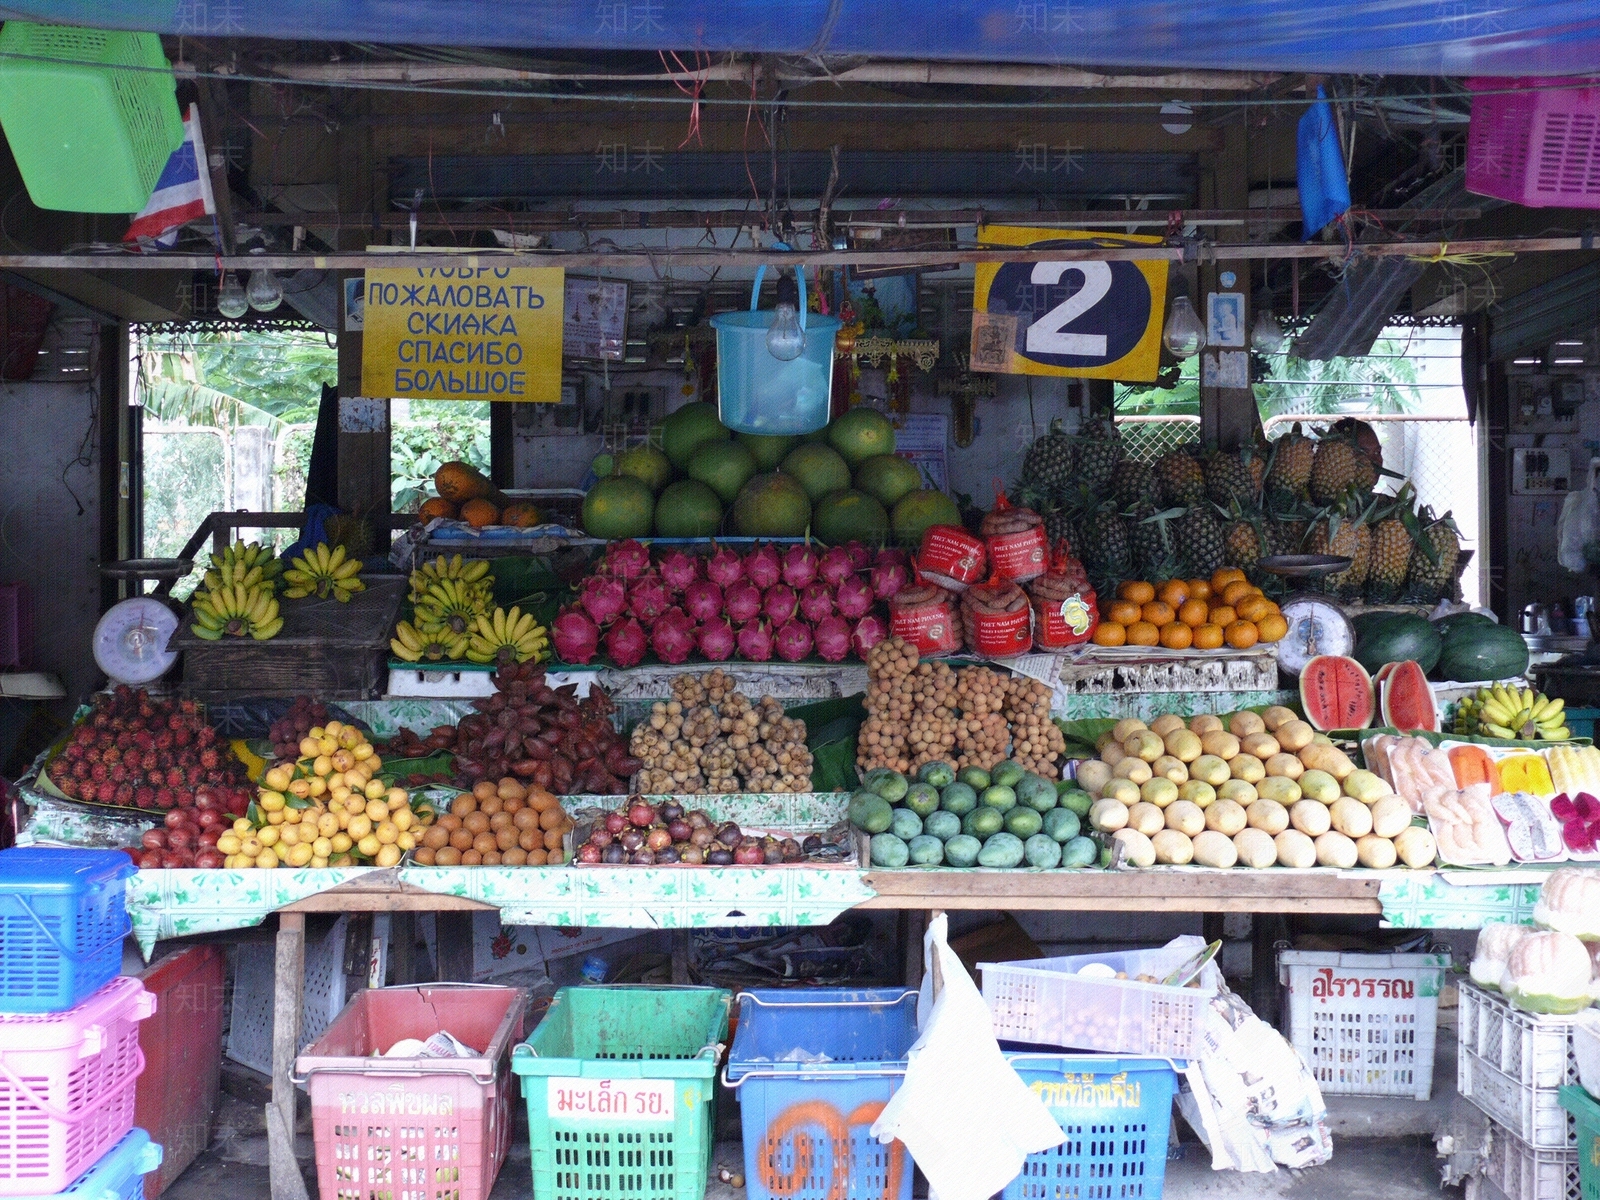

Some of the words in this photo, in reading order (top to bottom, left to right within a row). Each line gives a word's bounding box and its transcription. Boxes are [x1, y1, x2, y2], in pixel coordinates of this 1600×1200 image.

[368, 282, 545, 310] ПОЖАЛОВАТЬ
[1026, 260, 1113, 357] 2
[398, 339, 524, 366] СПАСИБО
[394, 368, 527, 395] БОЛЬШОЕ
[1312, 968, 1414, 1004] อุไรวรรณ
[557, 1079, 627, 1113] มะเล็ก
[634, 1091, 669, 1115] รย.
